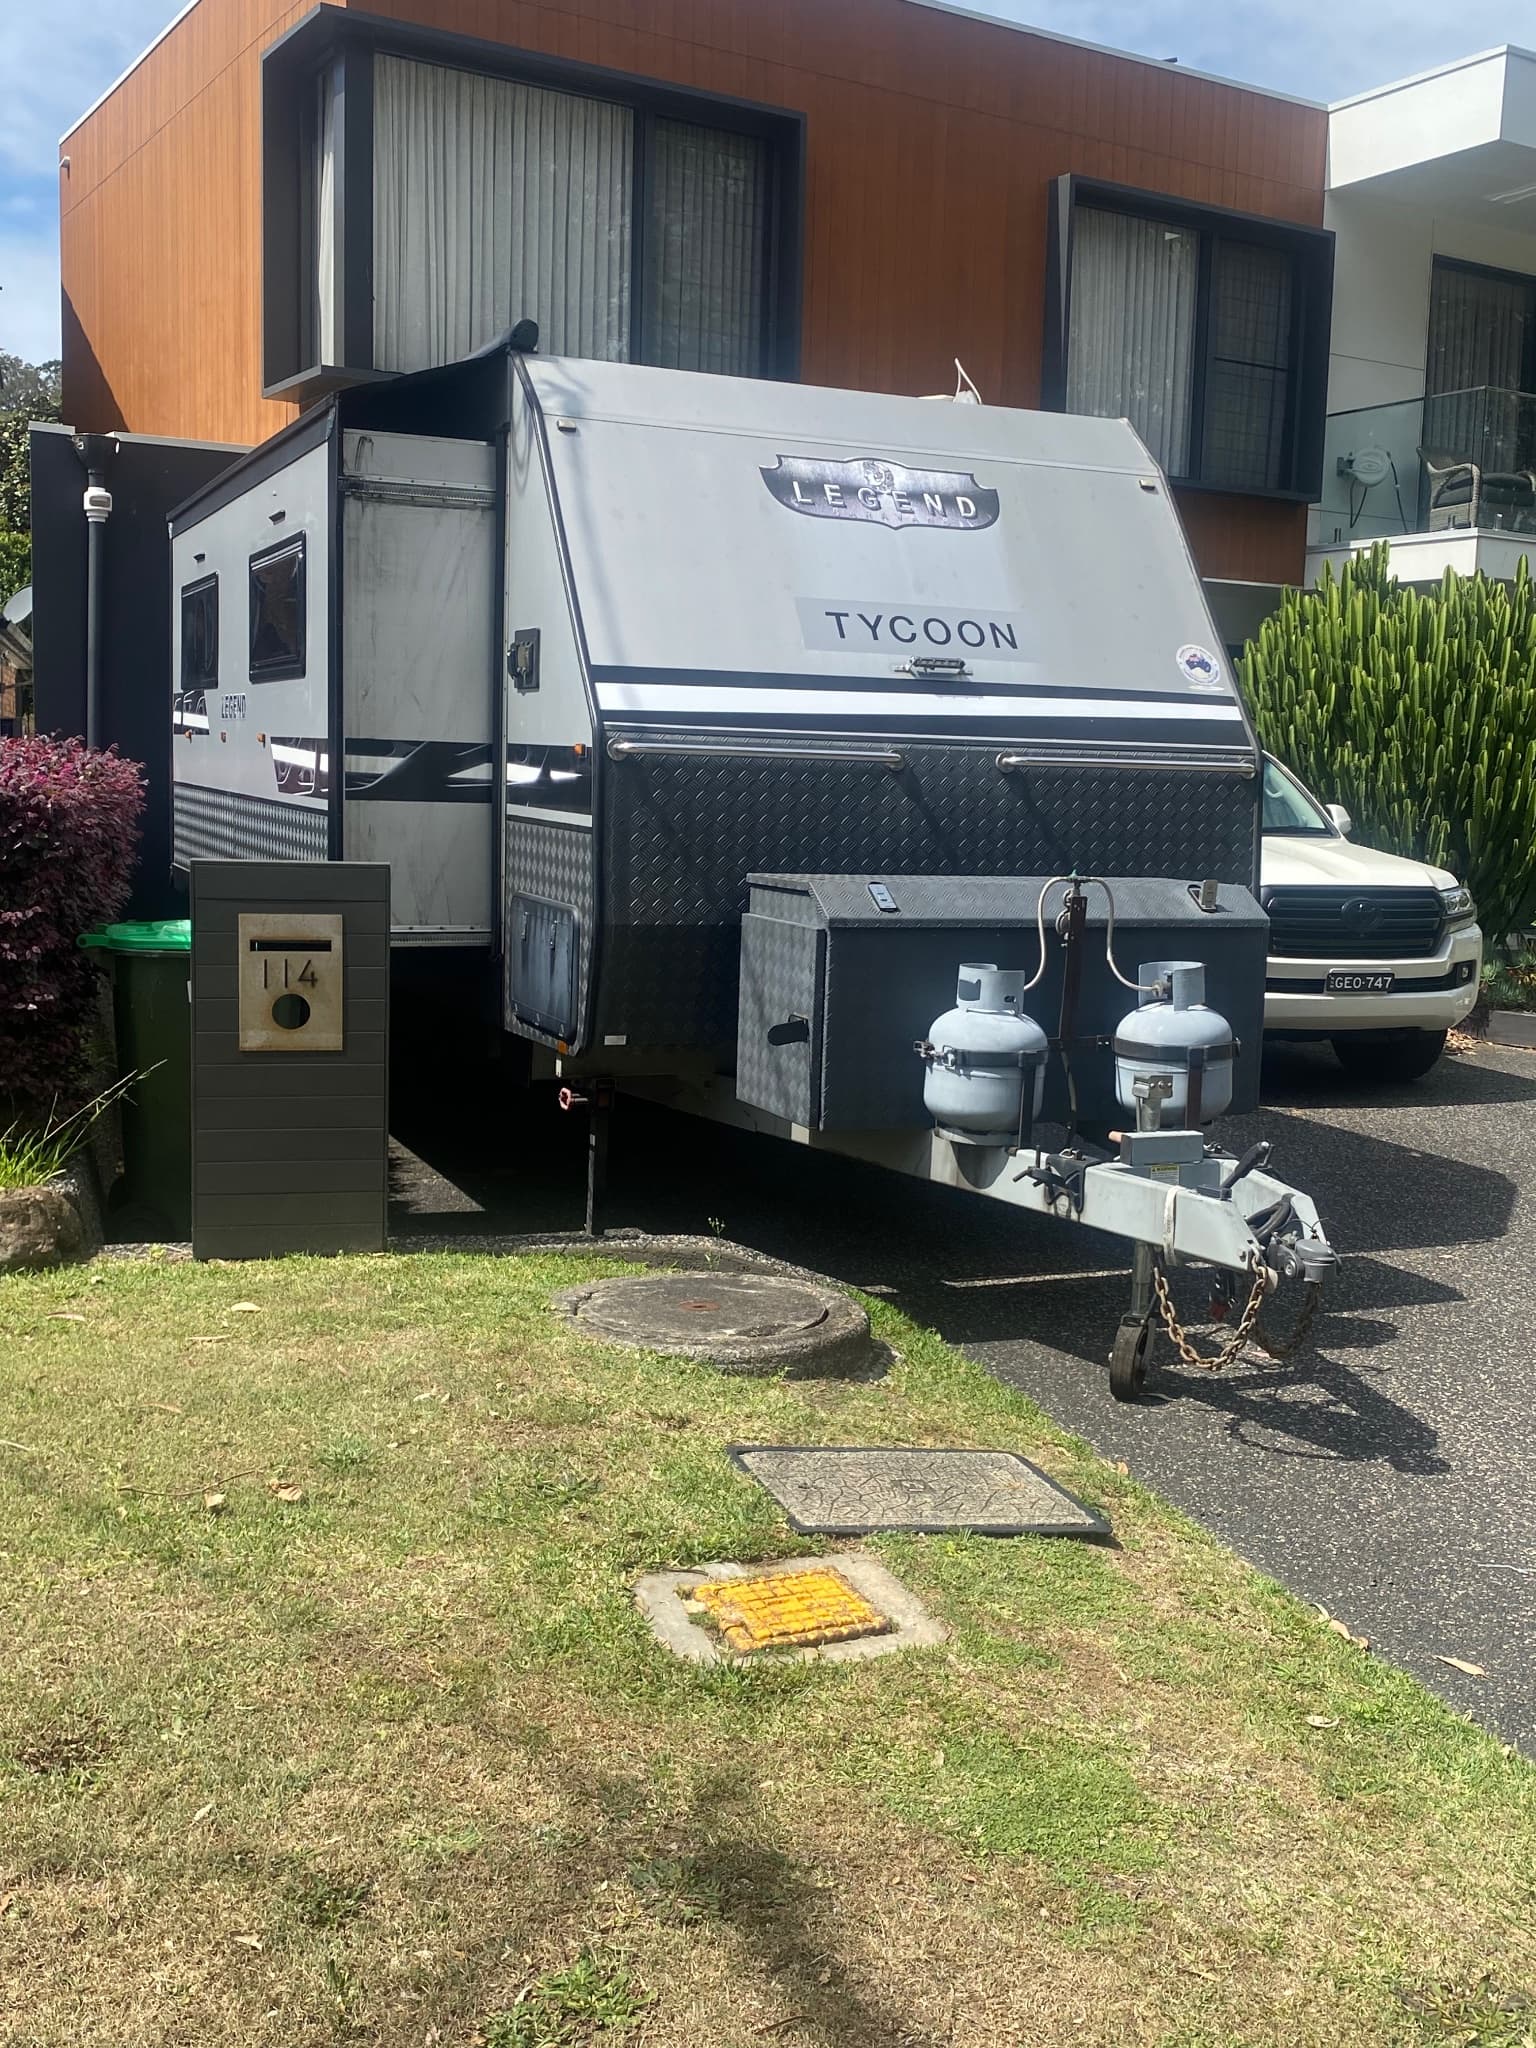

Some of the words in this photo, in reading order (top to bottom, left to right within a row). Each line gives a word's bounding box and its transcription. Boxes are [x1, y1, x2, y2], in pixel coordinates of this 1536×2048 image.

[791, 481, 978, 519] LEGEND
[824, 611, 1019, 650] TYCOON
[221, 694, 246, 719] LEGEND
[263, 958, 318, 989] 114
